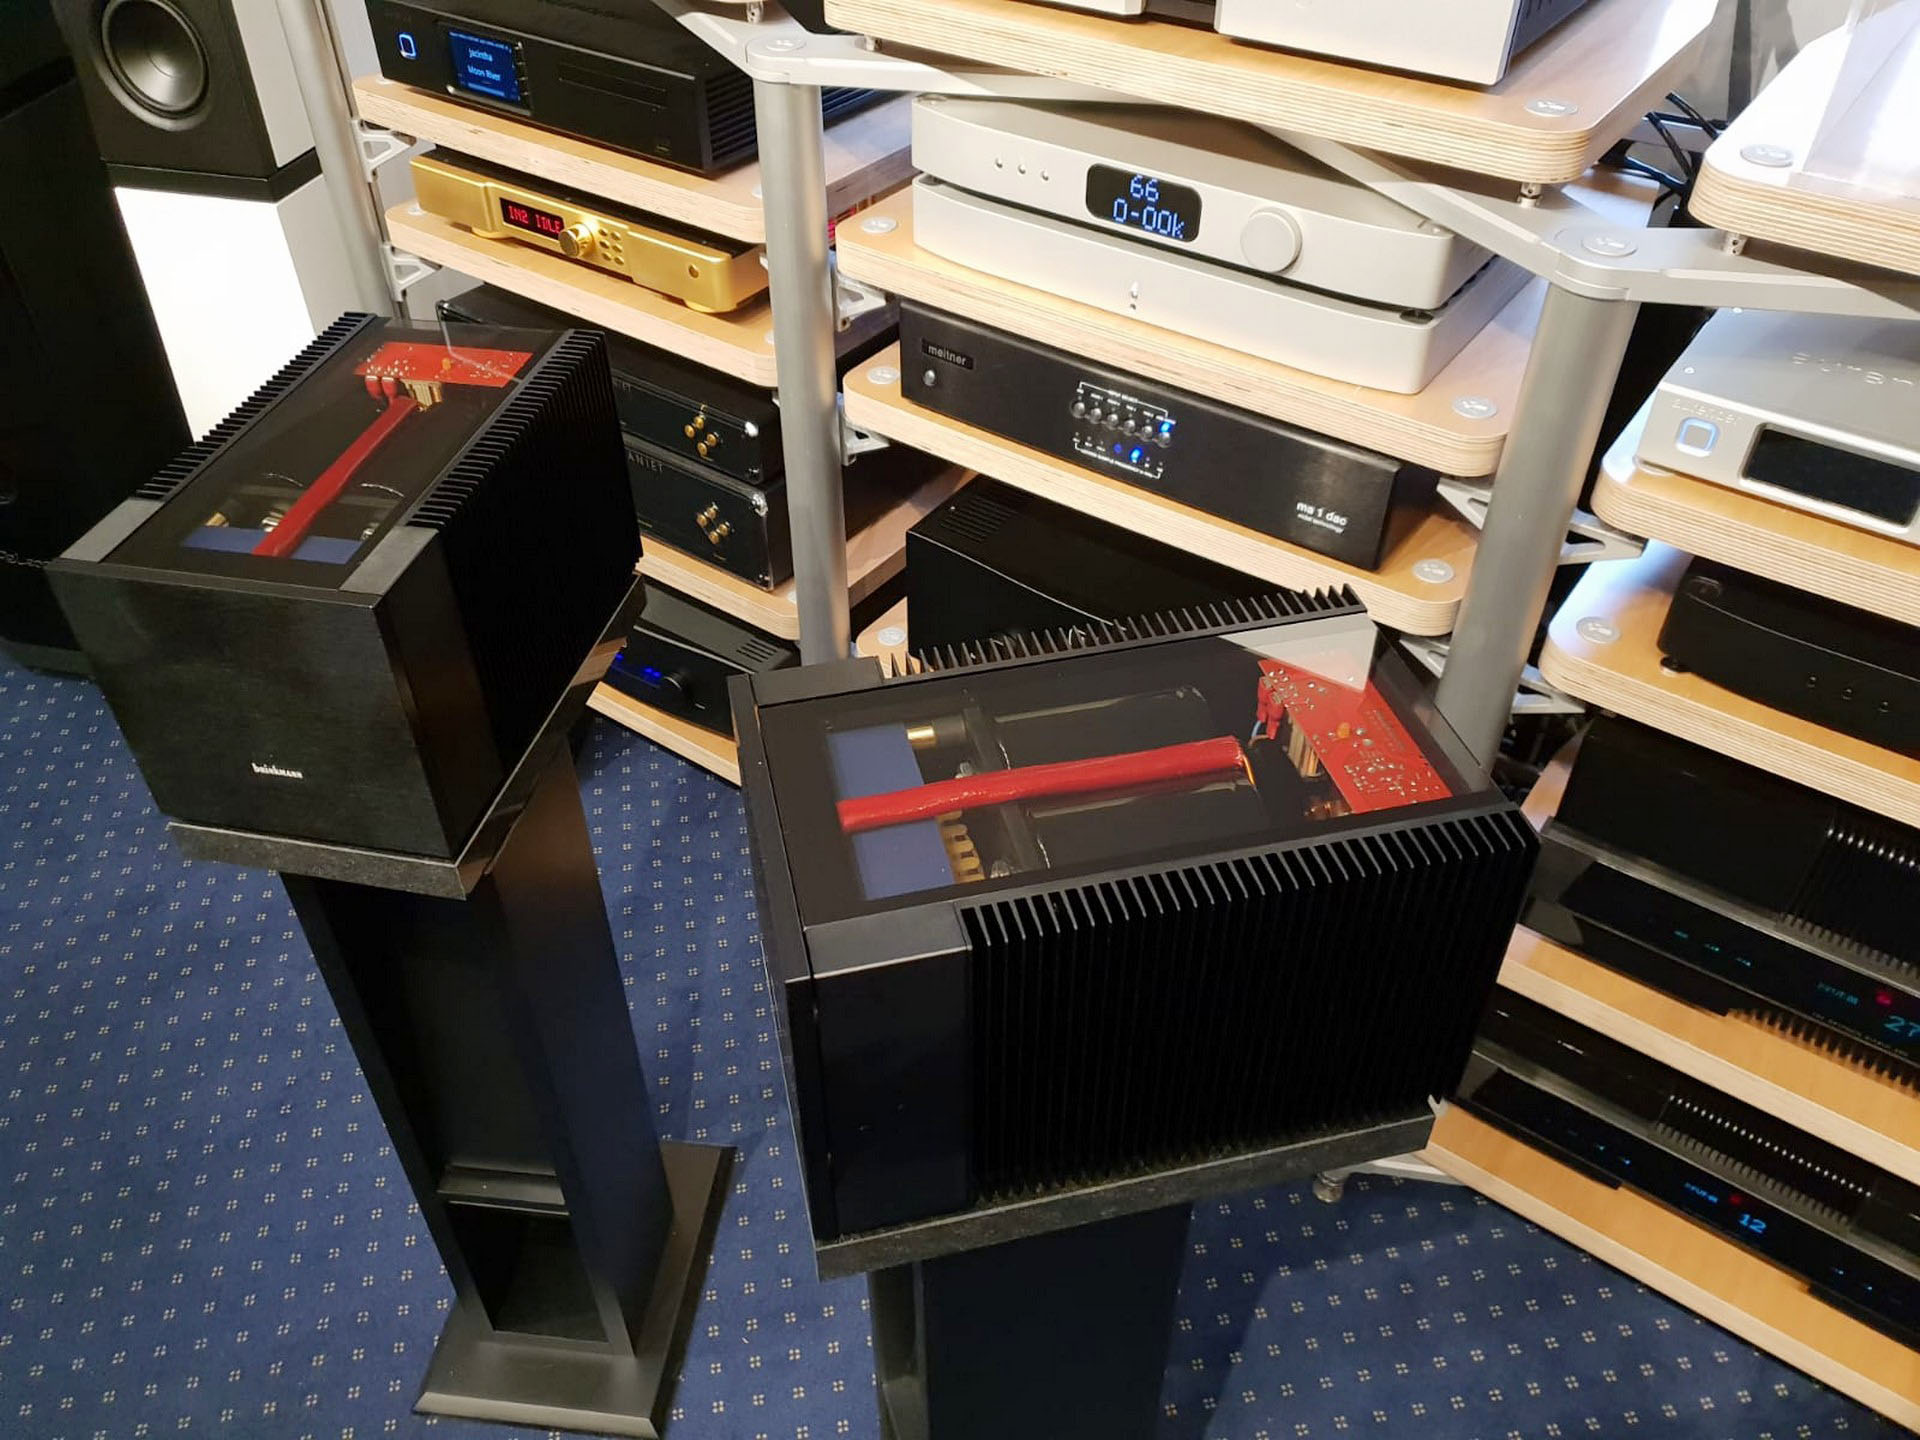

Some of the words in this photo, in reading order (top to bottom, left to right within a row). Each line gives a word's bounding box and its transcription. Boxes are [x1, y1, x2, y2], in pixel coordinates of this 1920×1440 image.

[1130, 173, 1159, 202] 66
[928, 344, 967, 366] meitner
[1296, 502, 1314, 515] ma
[1316, 507, 1324, 518] 1
[1739, 1213, 1767, 1234] 12
